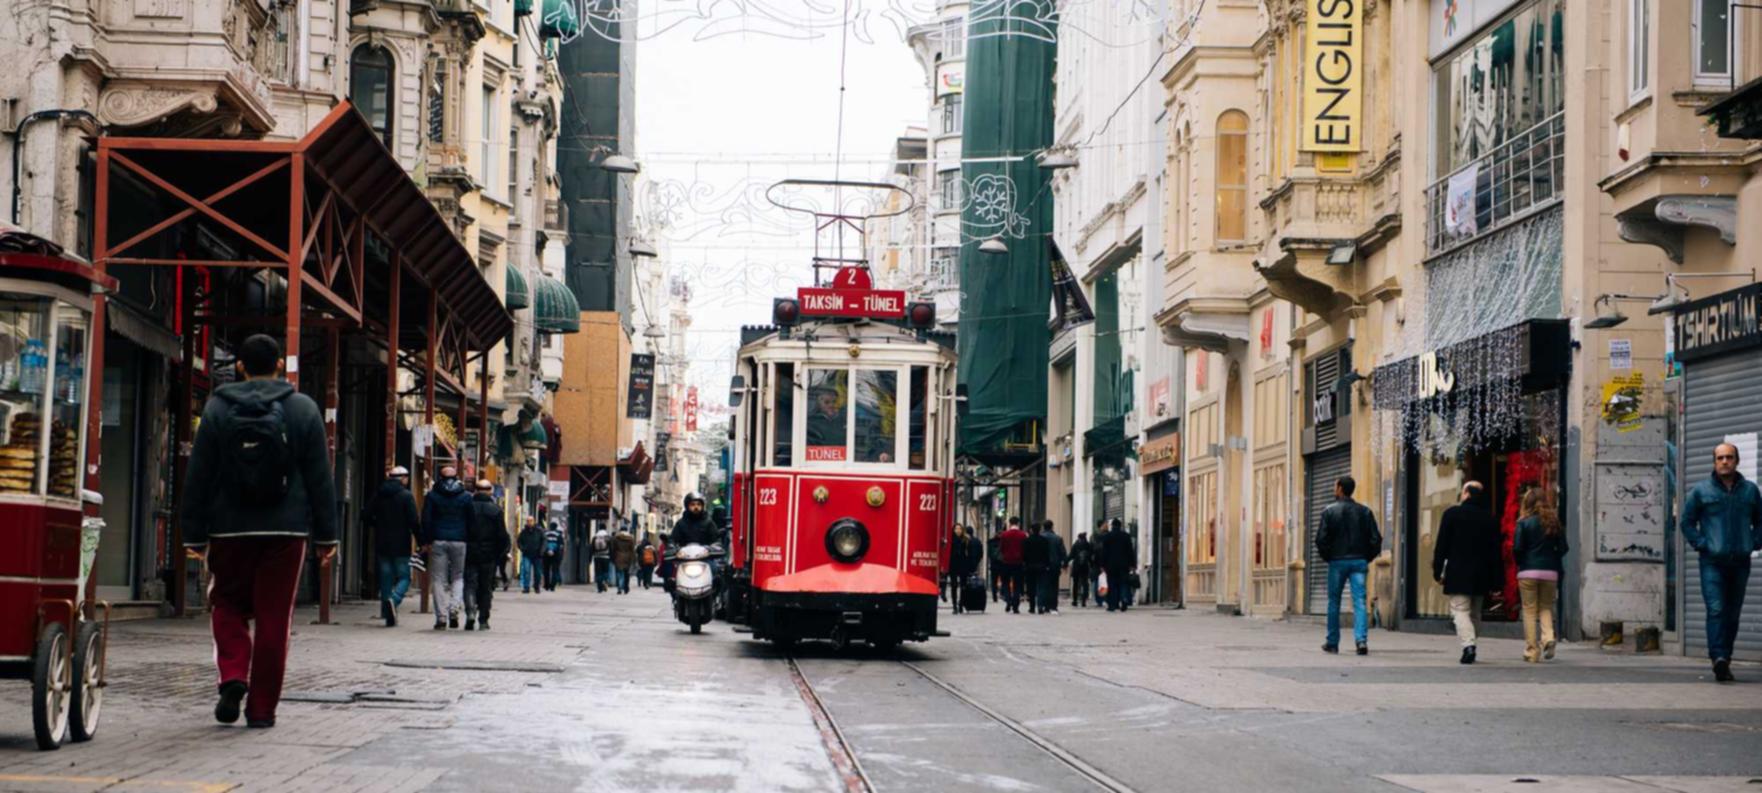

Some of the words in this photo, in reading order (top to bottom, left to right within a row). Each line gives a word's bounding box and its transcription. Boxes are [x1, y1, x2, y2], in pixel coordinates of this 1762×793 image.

[1315, 0, 1353, 144] ENGLIS
[848, 268, 856, 284] 2
[804, 294, 843, 310] TAKSİM
[864, 296, 901, 312] TÜNEL
[760, 488, 777, 505] 223
